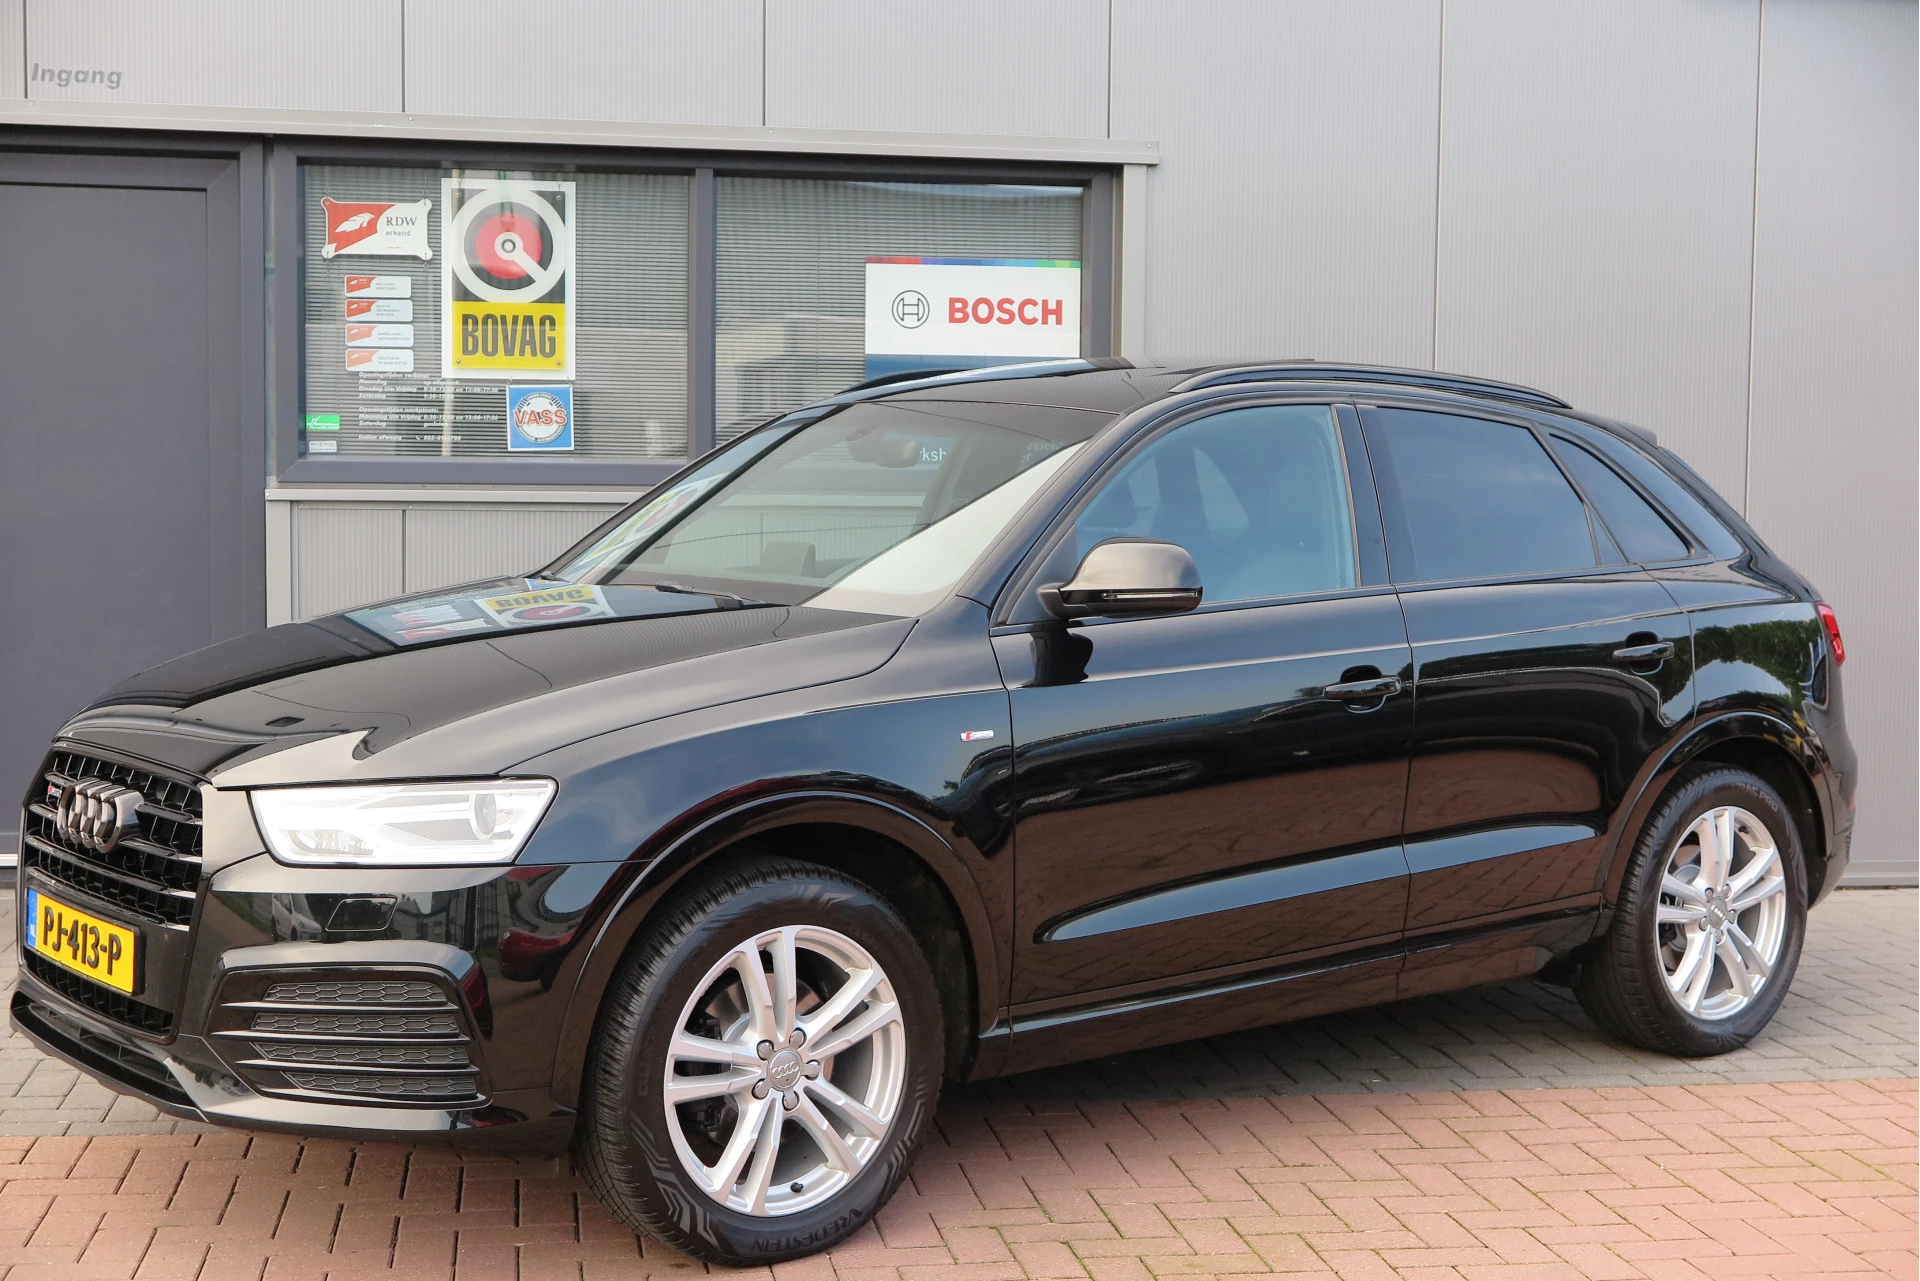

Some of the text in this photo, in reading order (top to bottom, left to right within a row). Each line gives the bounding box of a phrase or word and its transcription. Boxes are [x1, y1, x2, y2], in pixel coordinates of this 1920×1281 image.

[31, 62, 123, 90] Ingang
[385, 216, 418, 226] RDW
[385, 228, 411, 237] erkend
[948, 297, 1063, 326] BOSCH
[461, 313, 557, 358] BOVAG
[513, 408, 568, 425] VASS
[43, 905, 122, 976] PJ-413-P
[751, 1208, 863, 1253] VREDESTEIN
